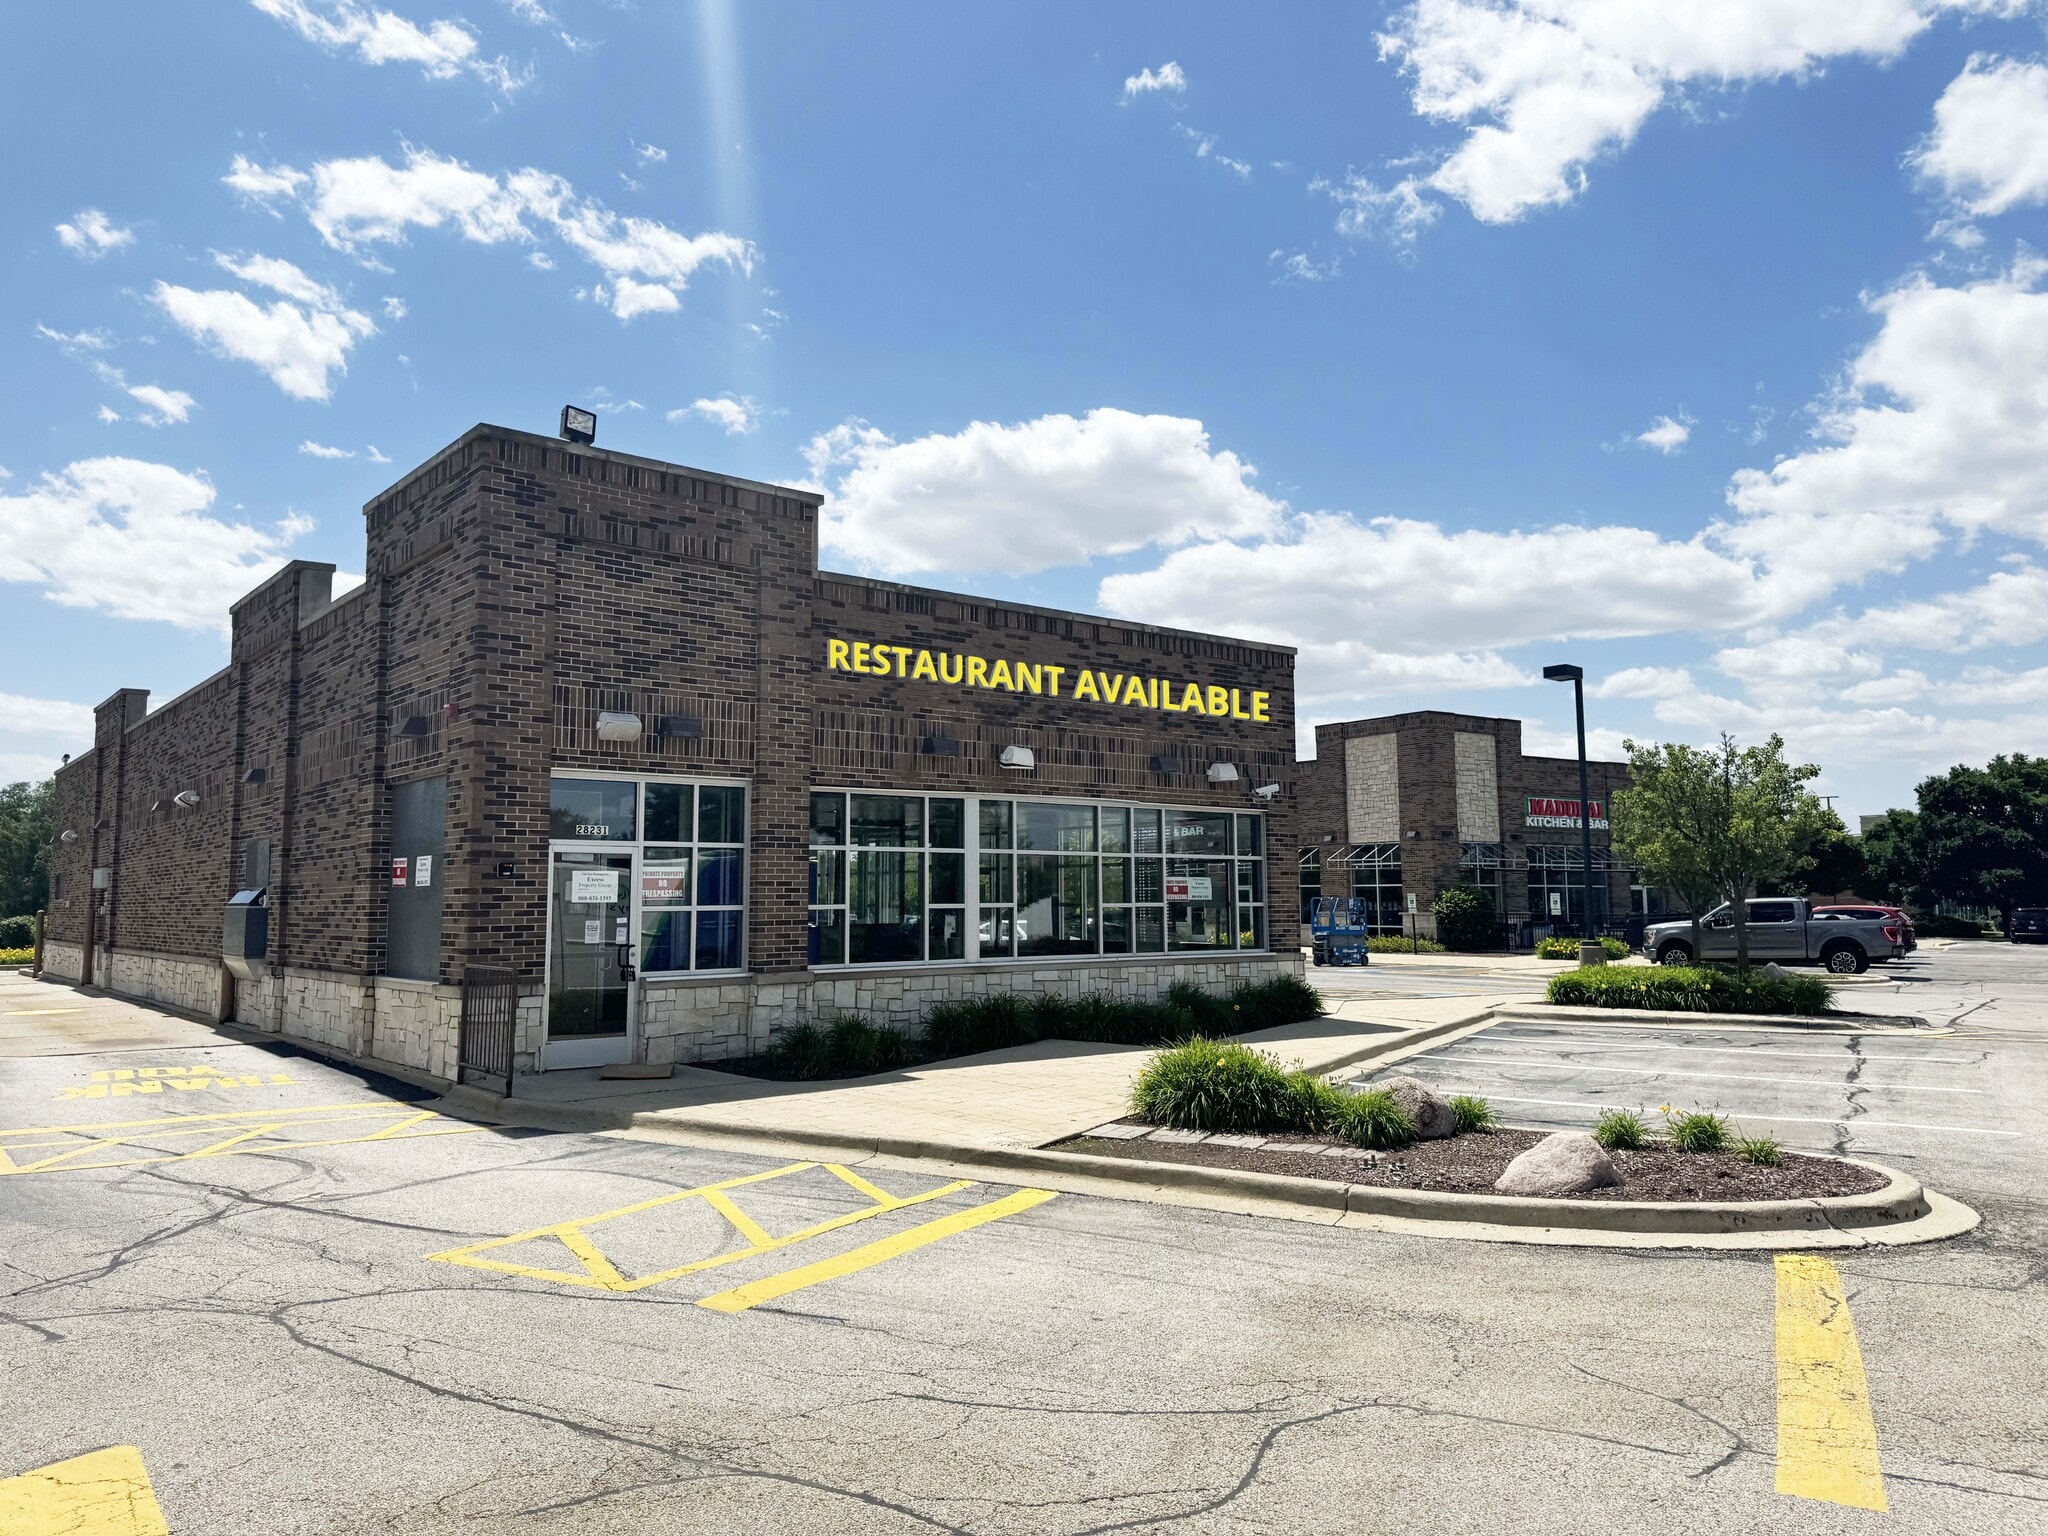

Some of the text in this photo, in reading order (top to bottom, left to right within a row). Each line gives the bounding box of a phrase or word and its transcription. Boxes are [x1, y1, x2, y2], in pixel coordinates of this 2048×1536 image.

[828, 638, 1270, 722] RESTAURANT AVAILABLE
[1529, 798, 1603, 818] MADUAI
[1526, 816, 1574, 829] KITCHEN
[576, 825, 608, 835] 28231
[658, 879, 668, 888] NO
